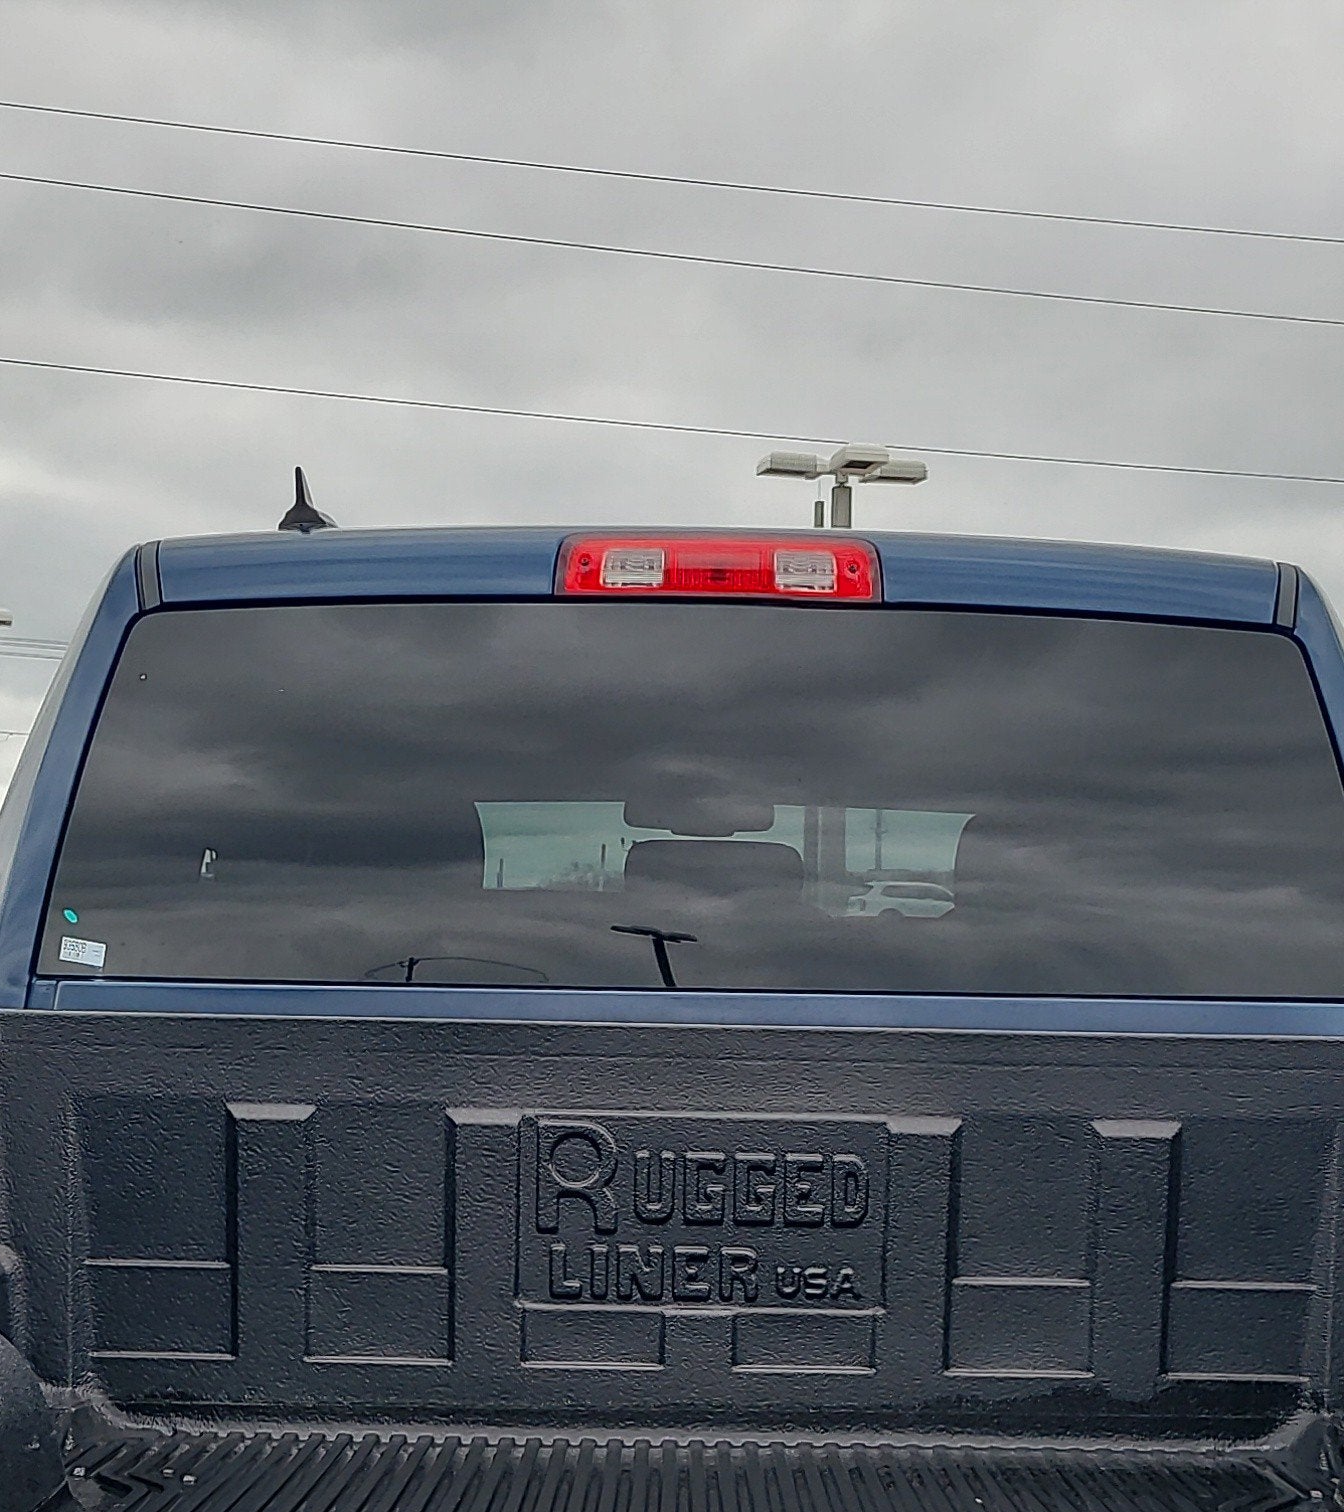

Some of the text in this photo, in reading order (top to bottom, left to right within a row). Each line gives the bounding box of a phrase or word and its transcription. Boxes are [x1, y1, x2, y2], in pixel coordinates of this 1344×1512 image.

[535, 1119, 869, 1234] RUGGED
[548, 1244, 860, 1300] LINER USA
